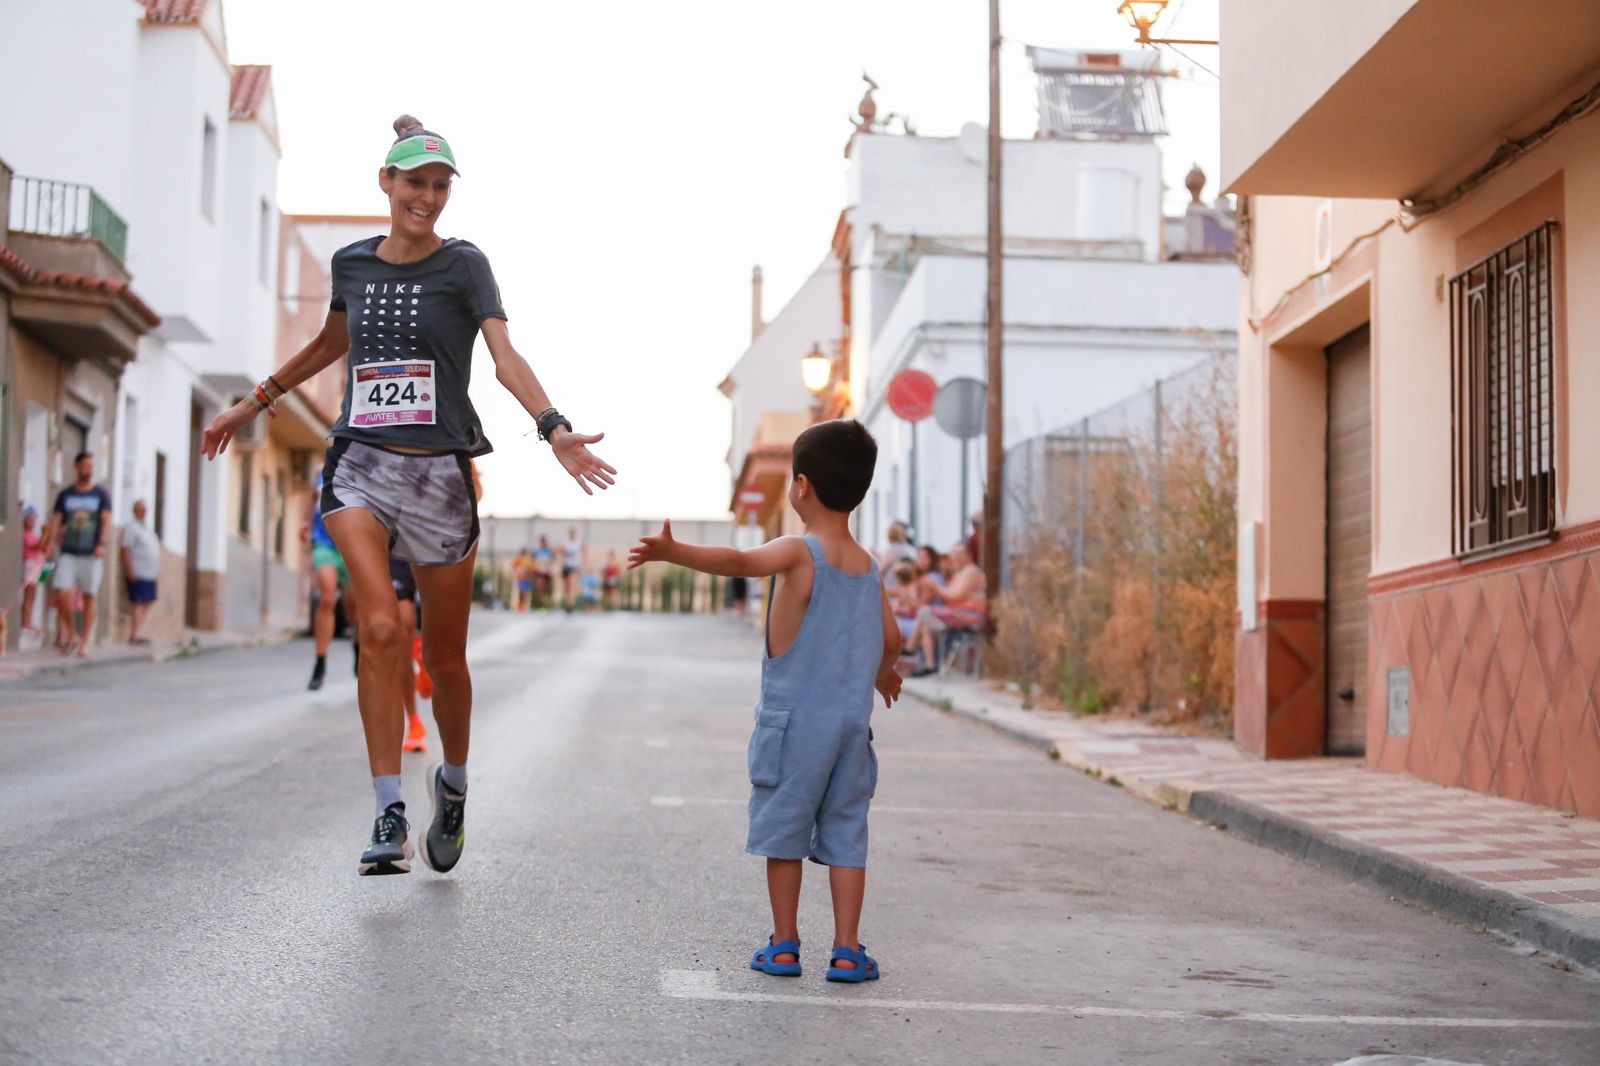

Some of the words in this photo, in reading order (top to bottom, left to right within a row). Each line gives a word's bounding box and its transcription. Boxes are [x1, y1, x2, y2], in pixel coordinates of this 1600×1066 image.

[365, 283, 422, 294] NIKE
[368, 381, 418, 406] 424
[365, 412, 398, 422] AVATEL
